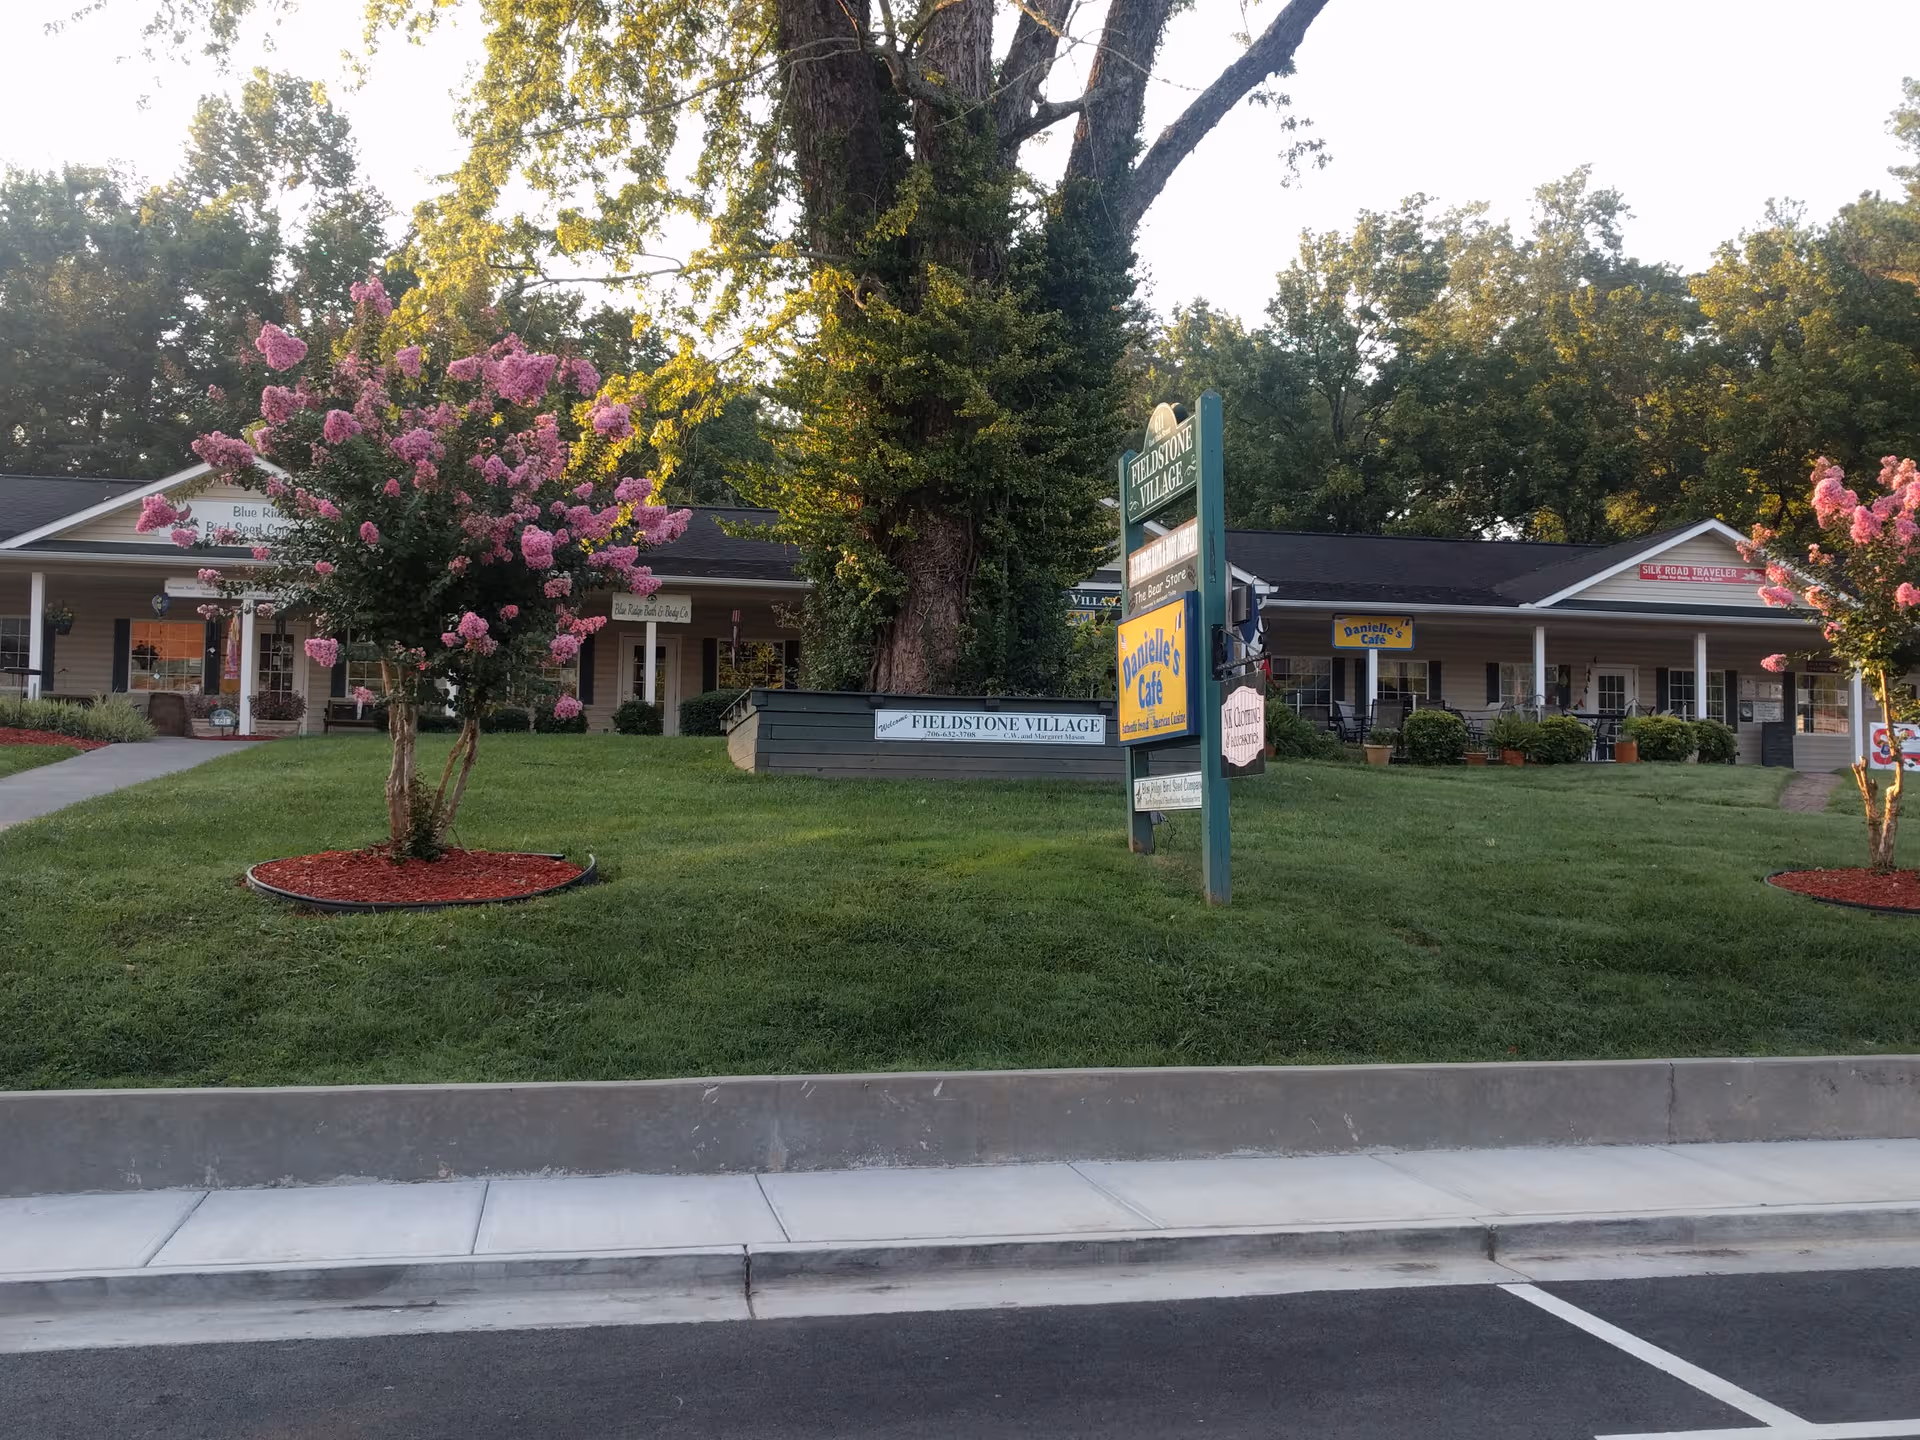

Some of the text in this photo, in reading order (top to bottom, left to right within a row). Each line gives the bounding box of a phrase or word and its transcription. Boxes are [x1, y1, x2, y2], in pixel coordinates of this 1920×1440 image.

[1131, 424, 1193, 488] FIELDSTONE
[1140, 460, 1183, 508] VILLAGE
[233, 505, 257, 518] Blue
[1642, 565, 1737, 578] SILK ROAD TRAVELER
[1134, 590, 1147, 605] The
[1147, 581, 1164, 599] Bear
[1165, 569, 1187, 589] Store
[614, 603, 627, 615] Blue
[628, 603, 643, 618] Ridge
[644, 604, 657, 617] Bath
[657, 605, 664, 617] &
[665, 605, 679, 620] Body
[1344, 621, 1403, 639] Danielle's
[1361, 633, 1386, 644] Café
[1122, 627, 1181, 692] Danielle's
[1138, 670, 1163, 709] Café
[878, 714, 1100, 733] Welcome FIELDSTONE VILLAGE
[926, 730, 976, 738] 706-632-3708
[1034, 733, 1063, 741] Margaret
[1183, 777, 1202, 794] Compan
